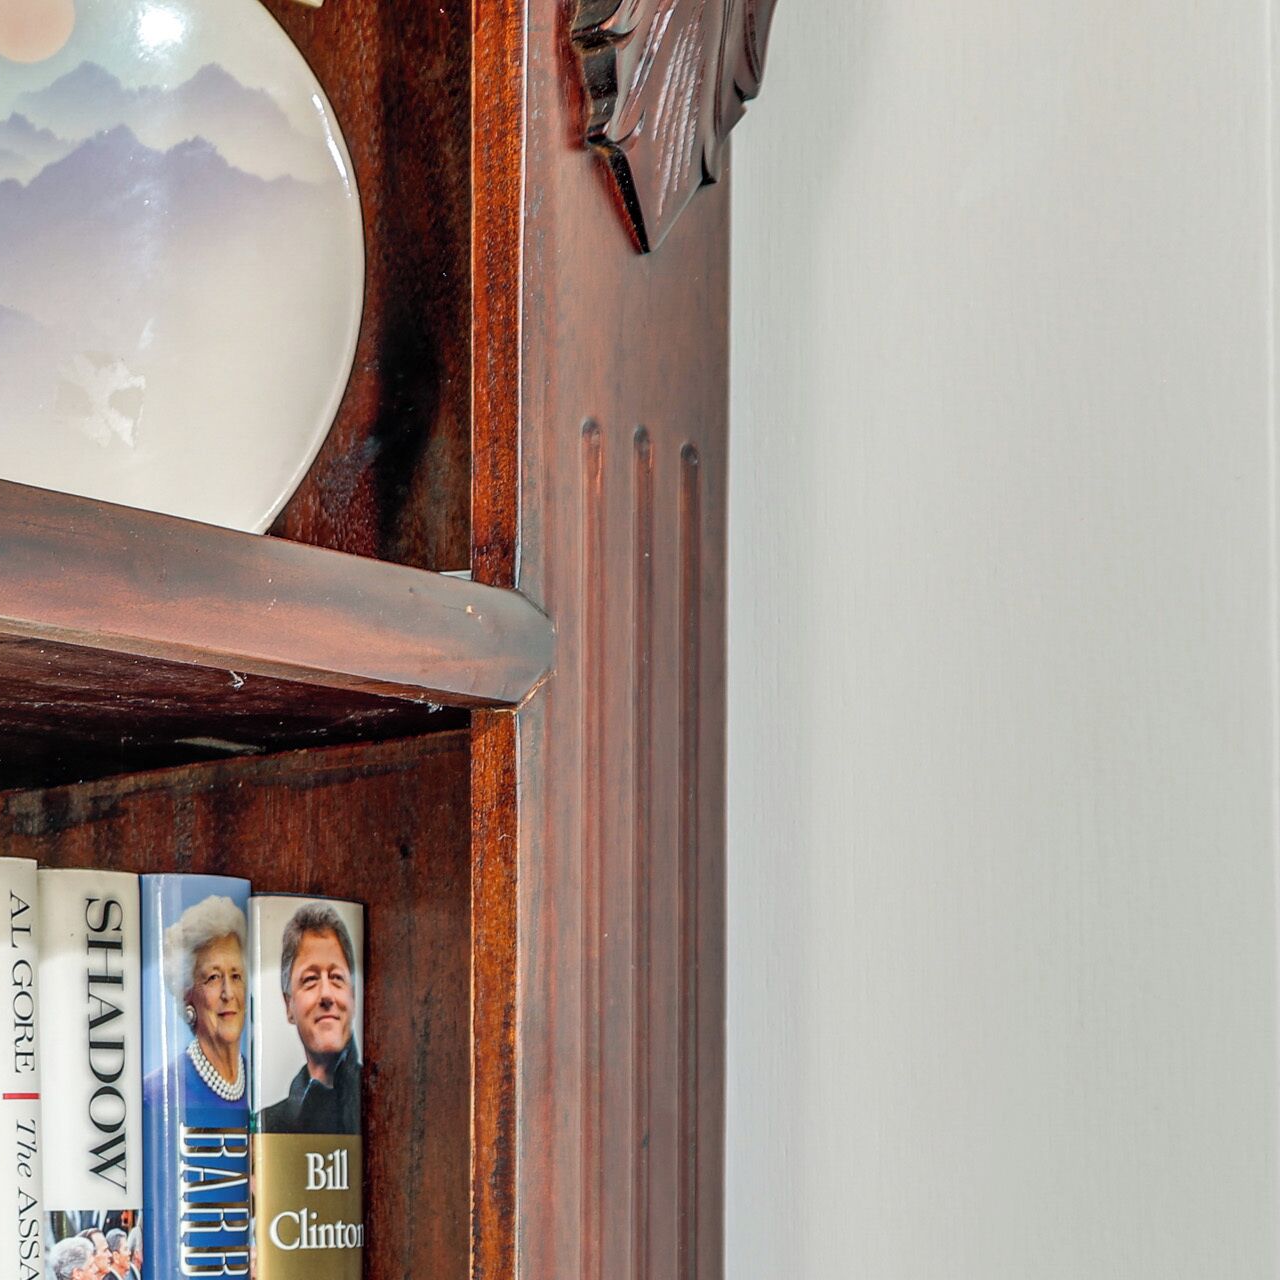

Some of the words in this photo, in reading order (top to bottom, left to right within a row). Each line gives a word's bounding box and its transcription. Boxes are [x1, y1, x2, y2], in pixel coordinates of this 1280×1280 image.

[10, 891, 32, 949] AL
[11, 959, 35, 1074] GORE
[85, 898, 127, 1195] SHADOW
[16, 1119, 36, 1177] The
[305, 1149, 350, 1192] Bill
[268, 1207, 364, 1252] Clinton
